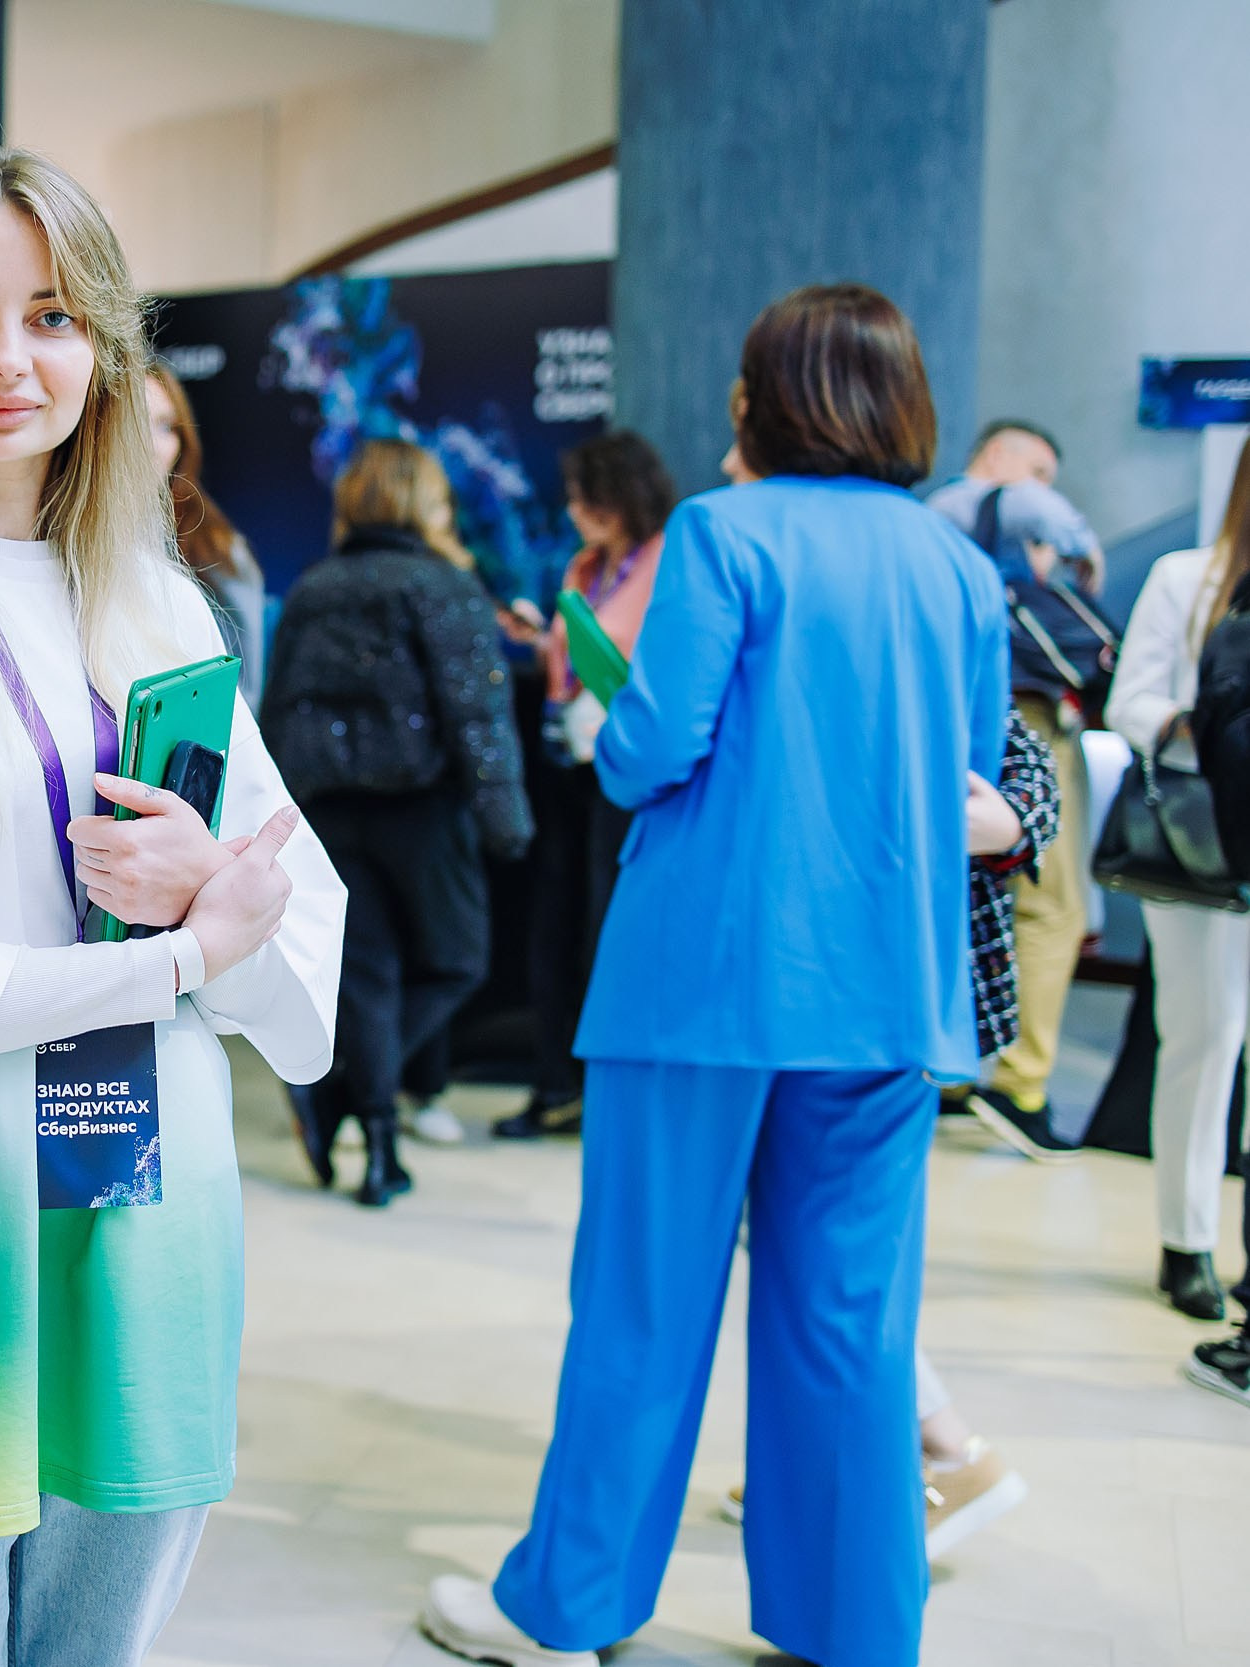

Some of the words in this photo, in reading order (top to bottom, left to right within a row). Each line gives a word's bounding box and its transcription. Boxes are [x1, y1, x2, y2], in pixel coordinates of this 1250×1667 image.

[49, 1043, 77, 1052] СБЕР
[37, 1083, 92, 1098] ЗНАЮ
[96, 1081, 130, 1096] ВСЕ
[41, 1099, 150, 1117] ПРОДУКТАХ
[37, 1120, 137, 1138] СберБизнес
